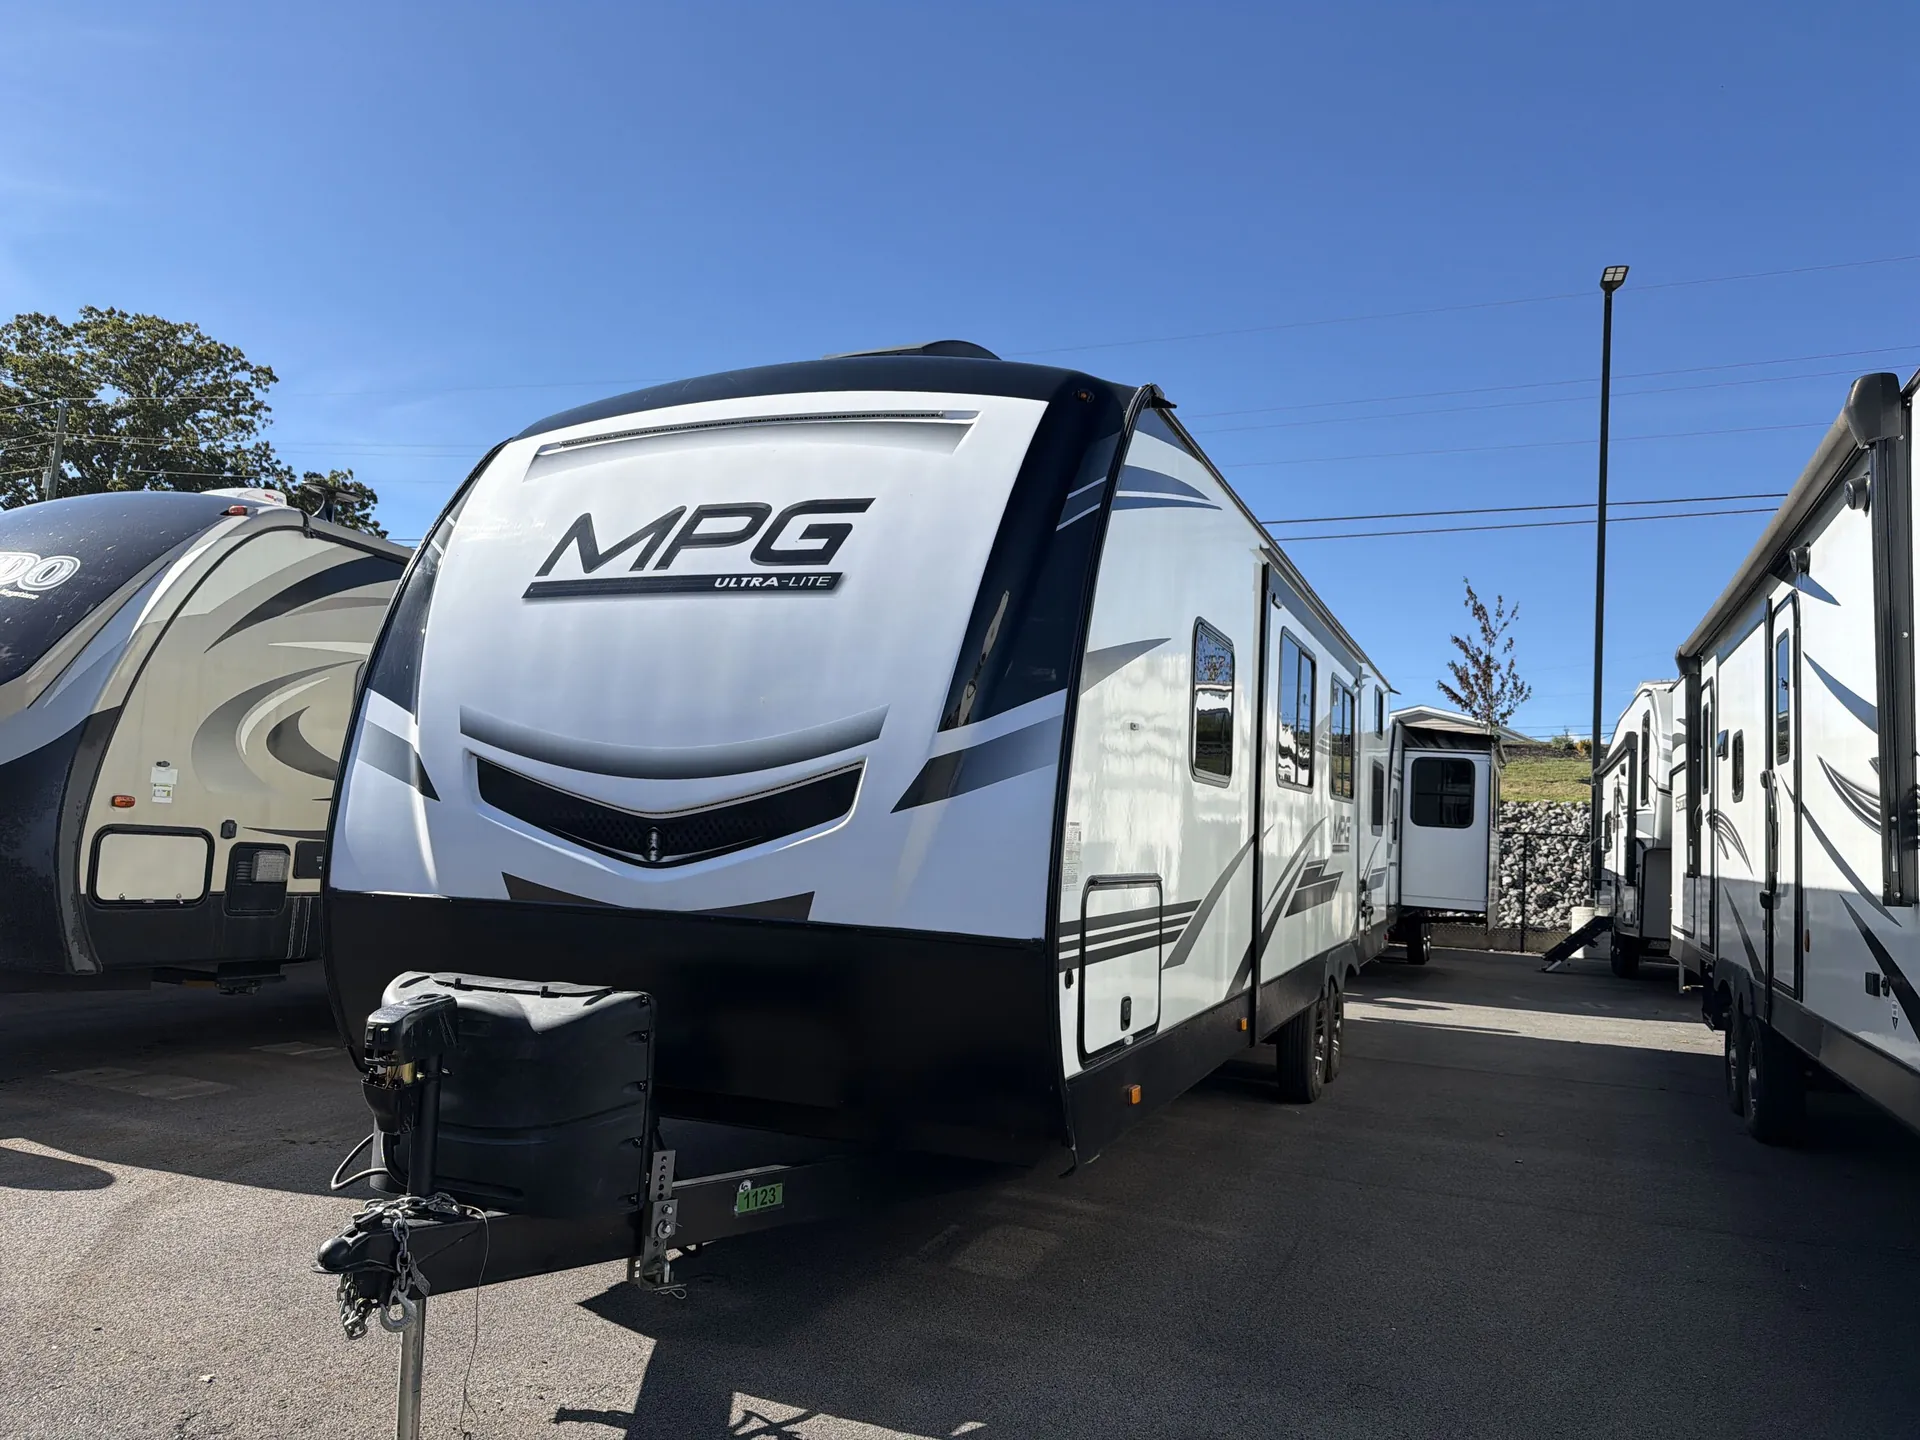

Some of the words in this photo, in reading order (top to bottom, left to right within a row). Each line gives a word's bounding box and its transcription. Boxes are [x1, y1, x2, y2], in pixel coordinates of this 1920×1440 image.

[535, 497, 876, 577] MPG
[714, 575, 832, 588] ULTRA-LITE
[743, 1186, 776, 1210] 1123
